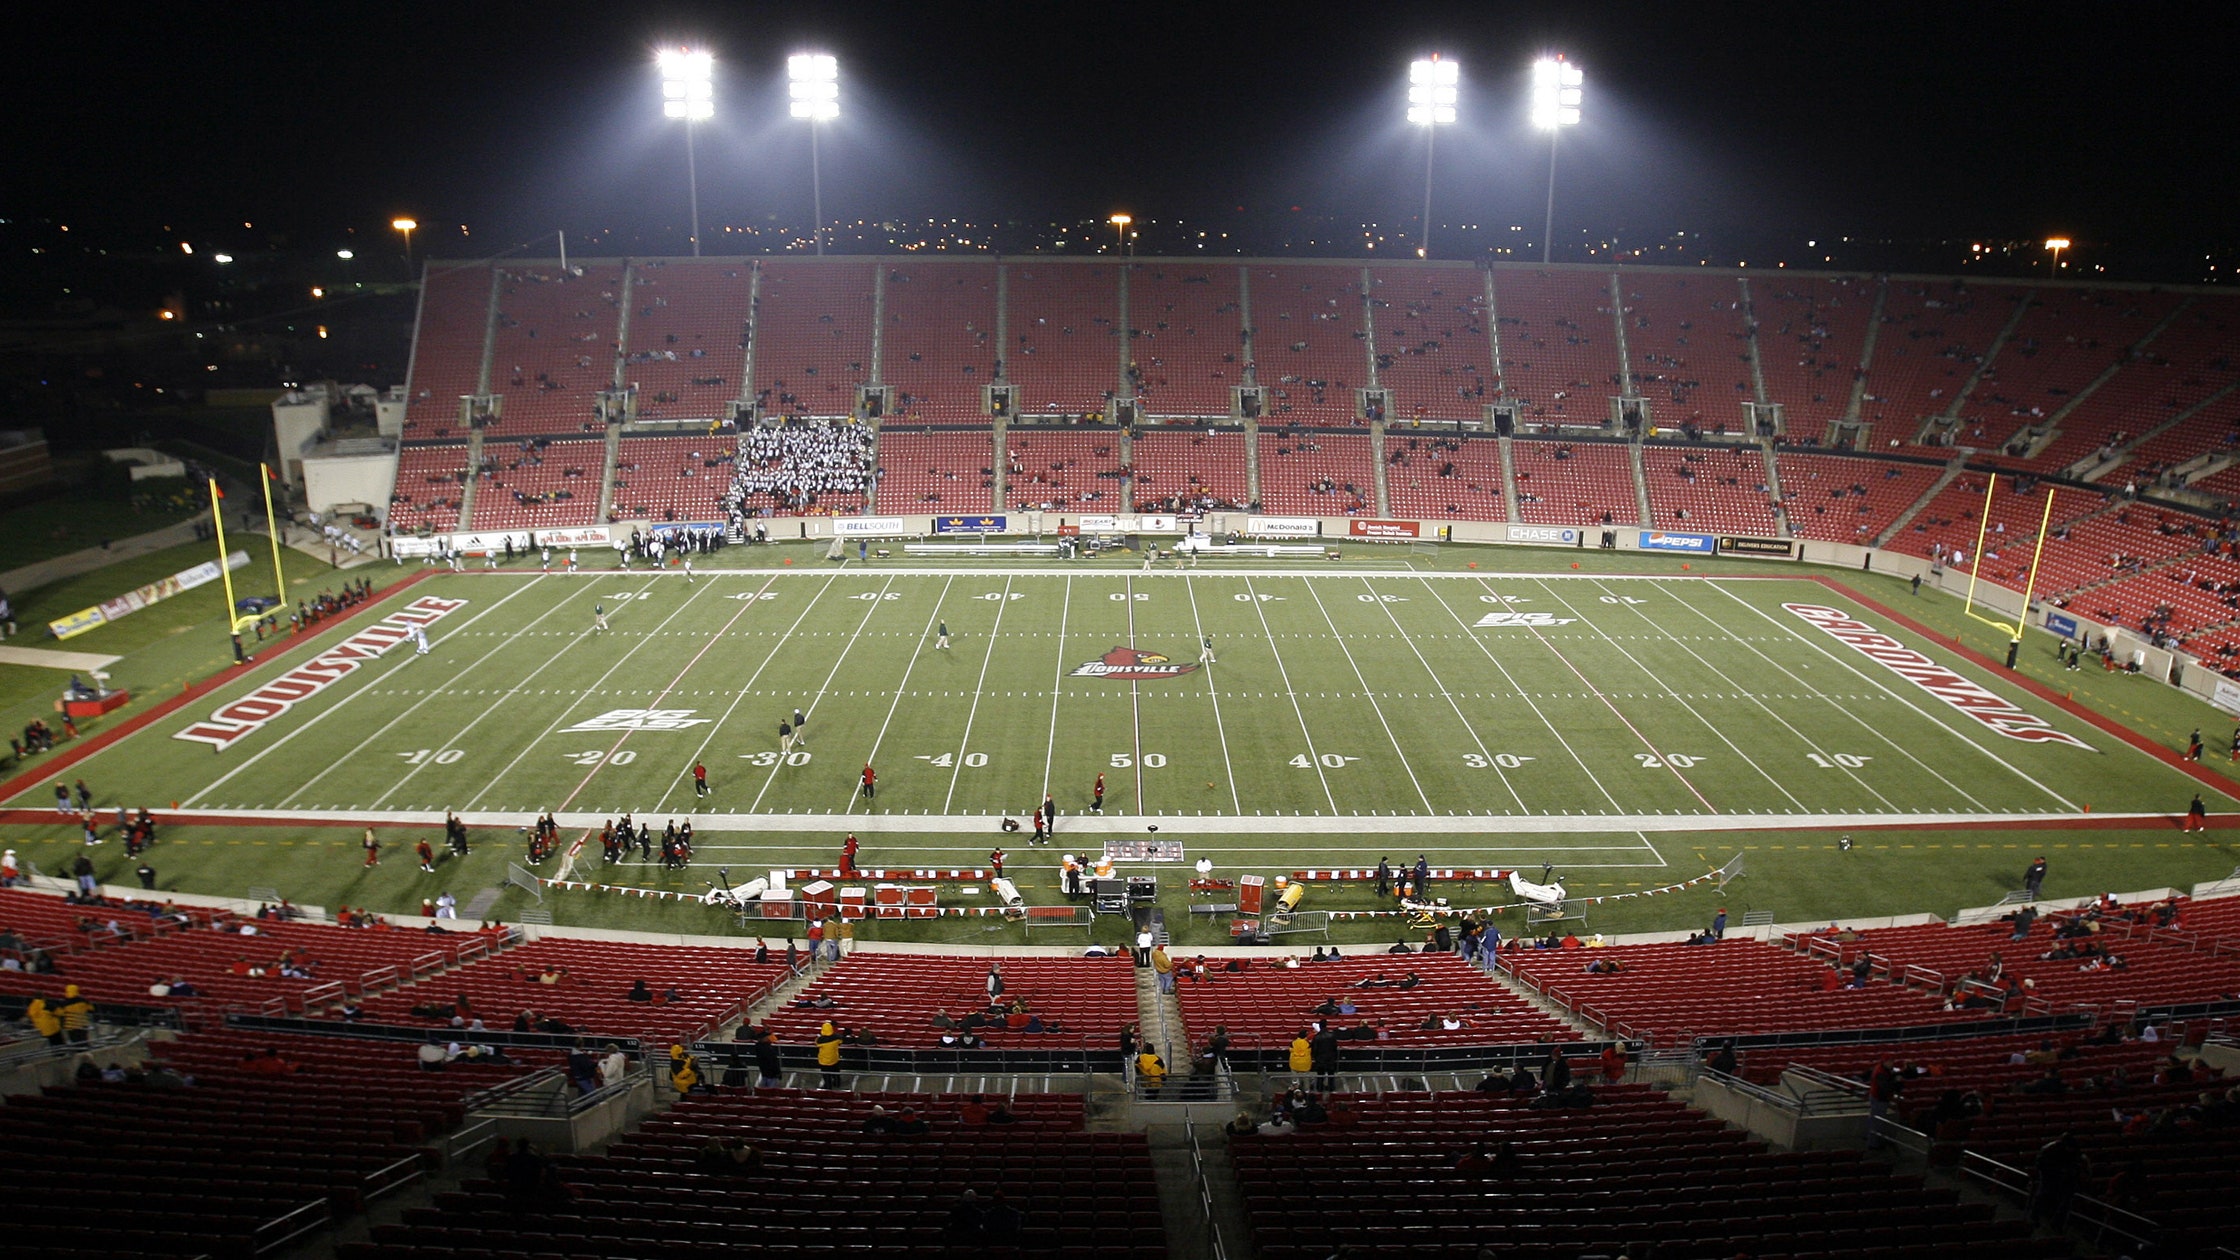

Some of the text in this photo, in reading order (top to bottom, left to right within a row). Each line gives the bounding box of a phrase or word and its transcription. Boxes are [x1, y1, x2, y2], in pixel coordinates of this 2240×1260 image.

[846, 522, 899, 531] BELLSOUTH
[1267, 523, 1314, 531] McDonald's
[1510, 529, 1558, 540] CHASE
[1663, 537, 1704, 547] PEPSI
[1760, 542, 1789, 551] EDUCATION
[172, 595, 469, 752] LOUISVILLE
[1069, 661, 1180, 676] LOUISVILLE
[1781, 602, 2099, 752] CARDINALS
[595, 709, 698, 719] BIG
[571, 718, 713, 729] EAST
[403, 749, 465, 765] 10
[574, 750, 637, 766] 20
[750, 751, 811, 767] 30
[930, 752, 989, 767] 40
[1109, 753, 1167, 768] 50
[1289, 753, 1346, 768] 40
[1462, 753, 1521, 768] 30
[1634, 753, 1696, 768] 20
[1806, 753, 1863, 768] 10
